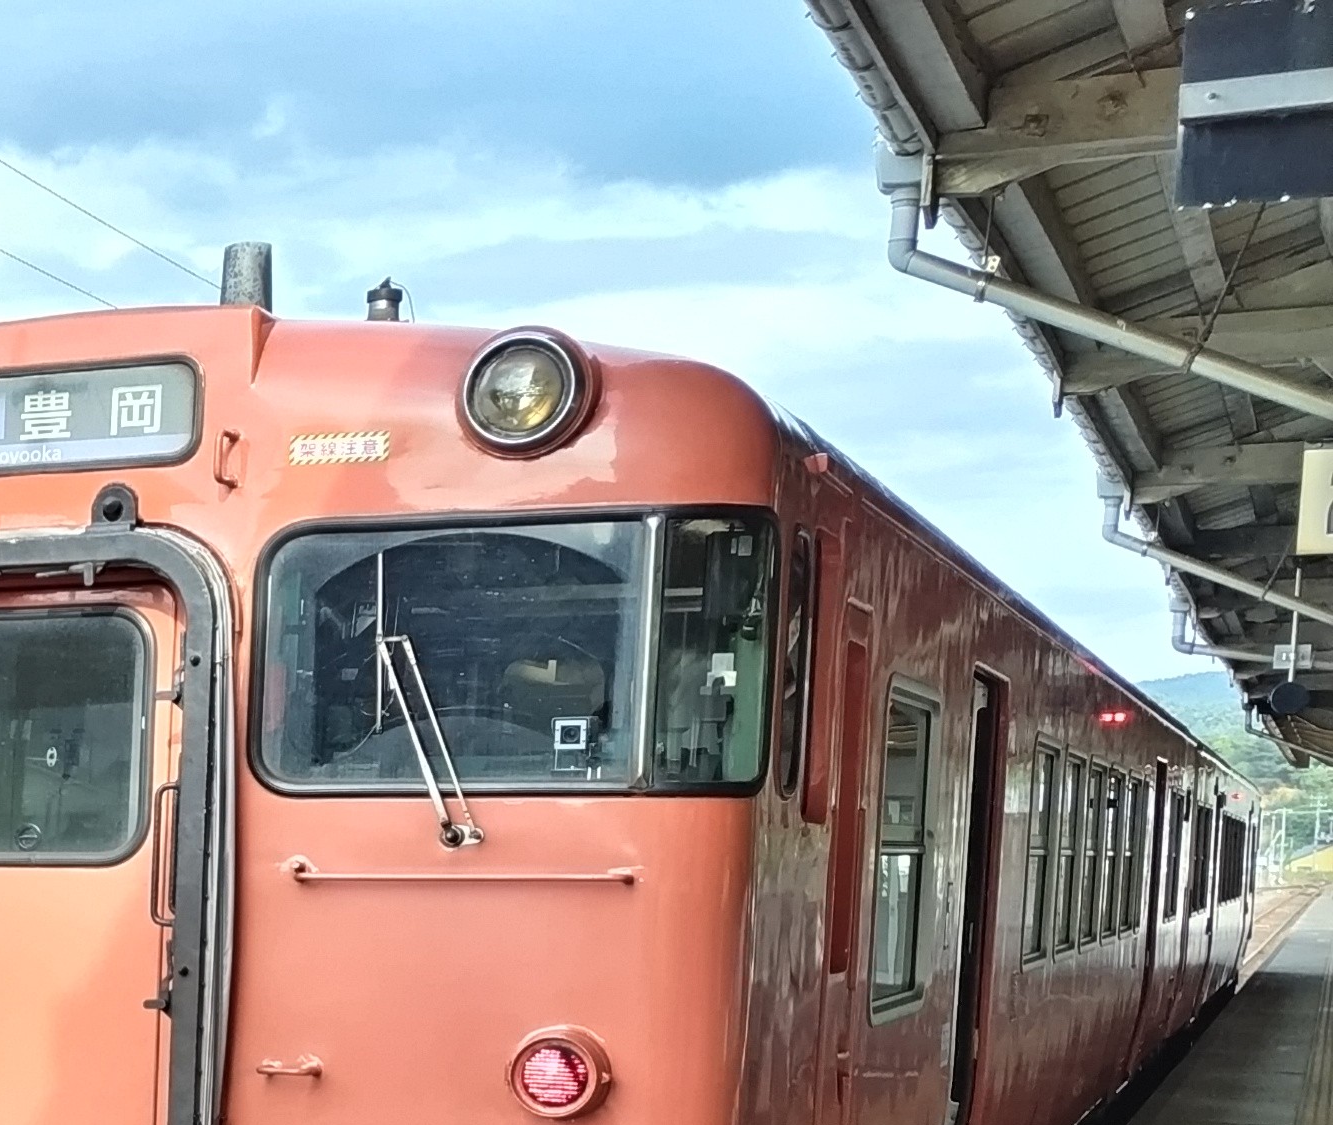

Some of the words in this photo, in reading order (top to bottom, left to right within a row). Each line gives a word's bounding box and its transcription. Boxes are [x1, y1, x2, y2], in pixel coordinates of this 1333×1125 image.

[19, 384, 163, 441] 豊岡
[299, 439, 379, 457] 架線注意
